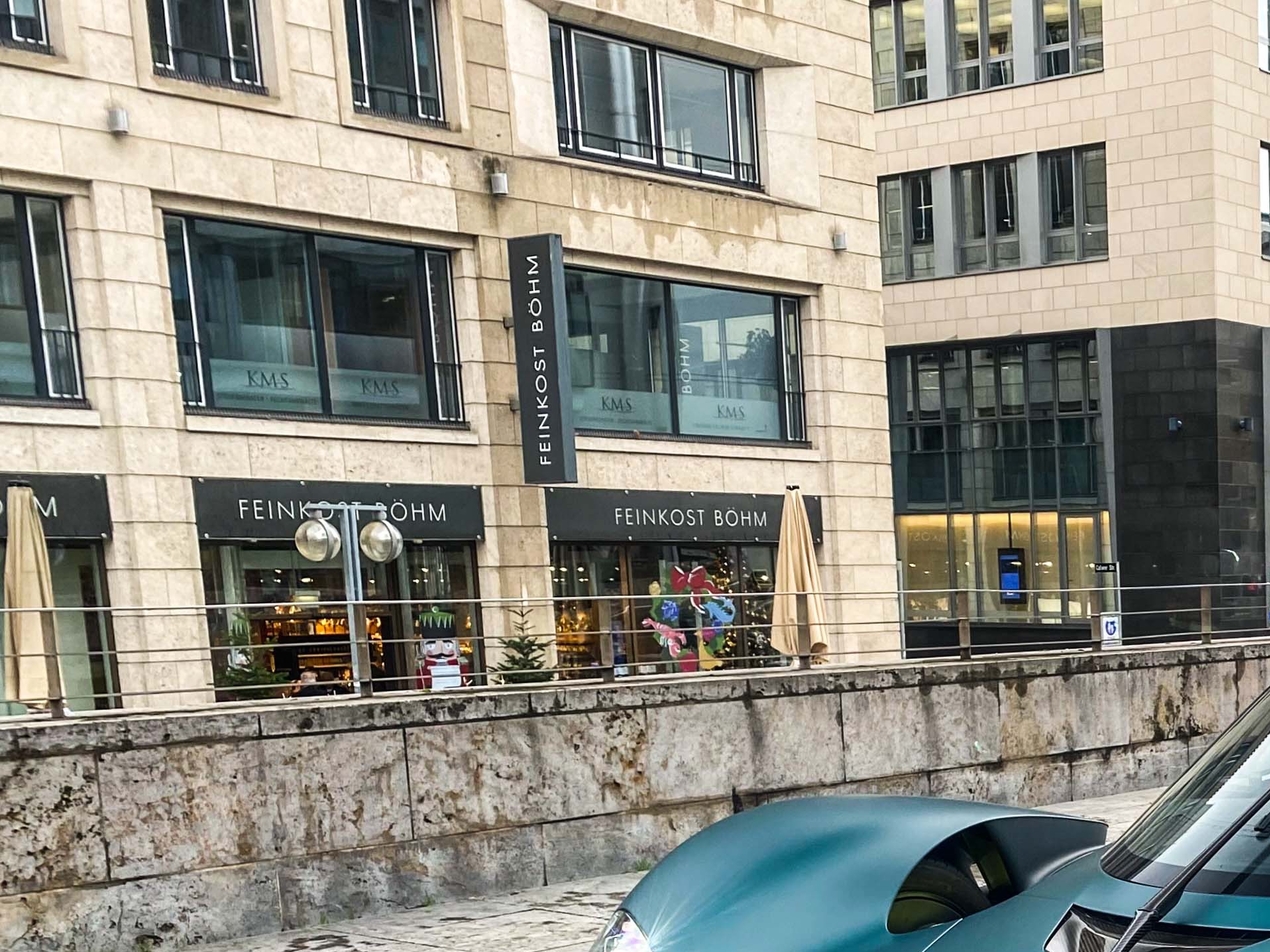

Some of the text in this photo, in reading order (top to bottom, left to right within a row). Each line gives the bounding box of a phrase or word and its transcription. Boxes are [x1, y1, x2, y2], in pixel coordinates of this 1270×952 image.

[525, 255, 552, 466] FEINKOST BÖHM
[615, 506, 768, 528] FEINKOST BÖHM
